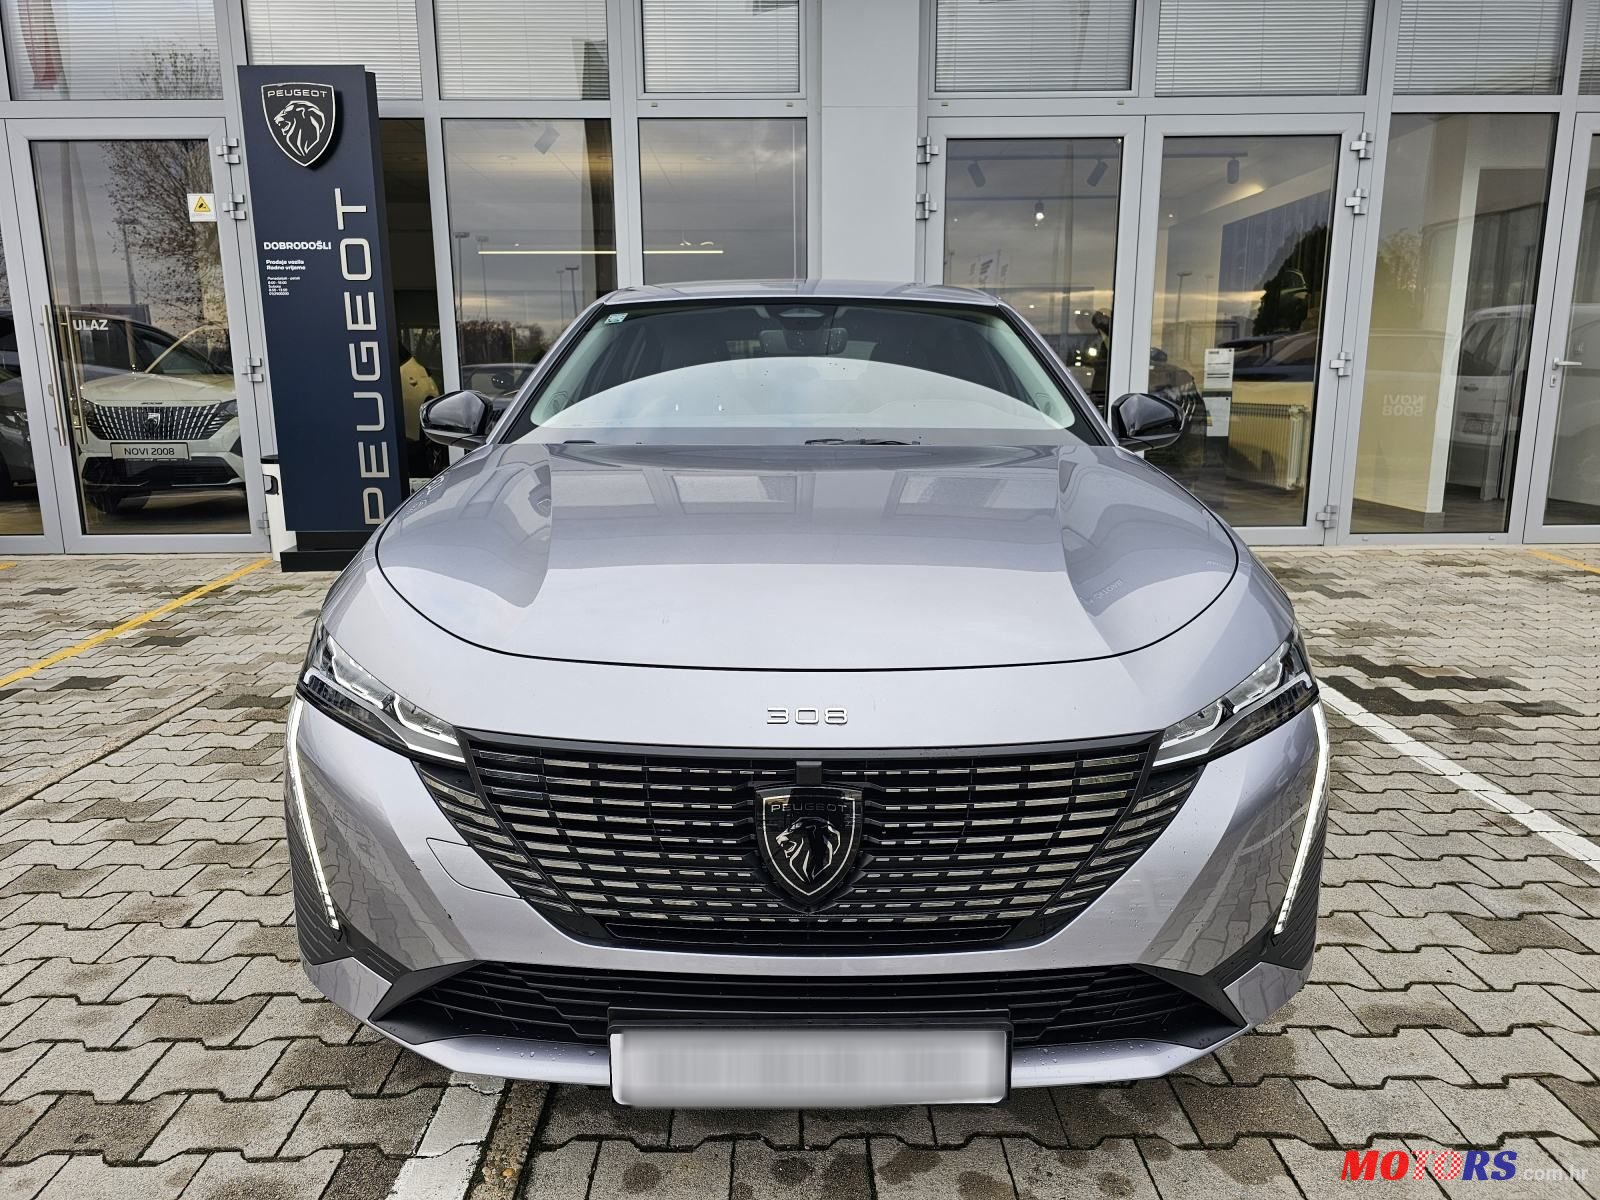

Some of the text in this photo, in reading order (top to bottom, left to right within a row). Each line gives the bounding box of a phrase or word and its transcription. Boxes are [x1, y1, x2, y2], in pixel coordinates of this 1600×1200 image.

[267, 89, 328, 98] PEUGEOT
[263, 240, 332, 250] DOBRODOŠLI
[72, 319, 109, 331] ULAZ
[334, 187, 390, 525] PEUGEOT
[124, 447, 175, 456] NOVI 2008
[766, 707, 848, 725] 308
[770, 803, 848, 813] PEUGEOT
